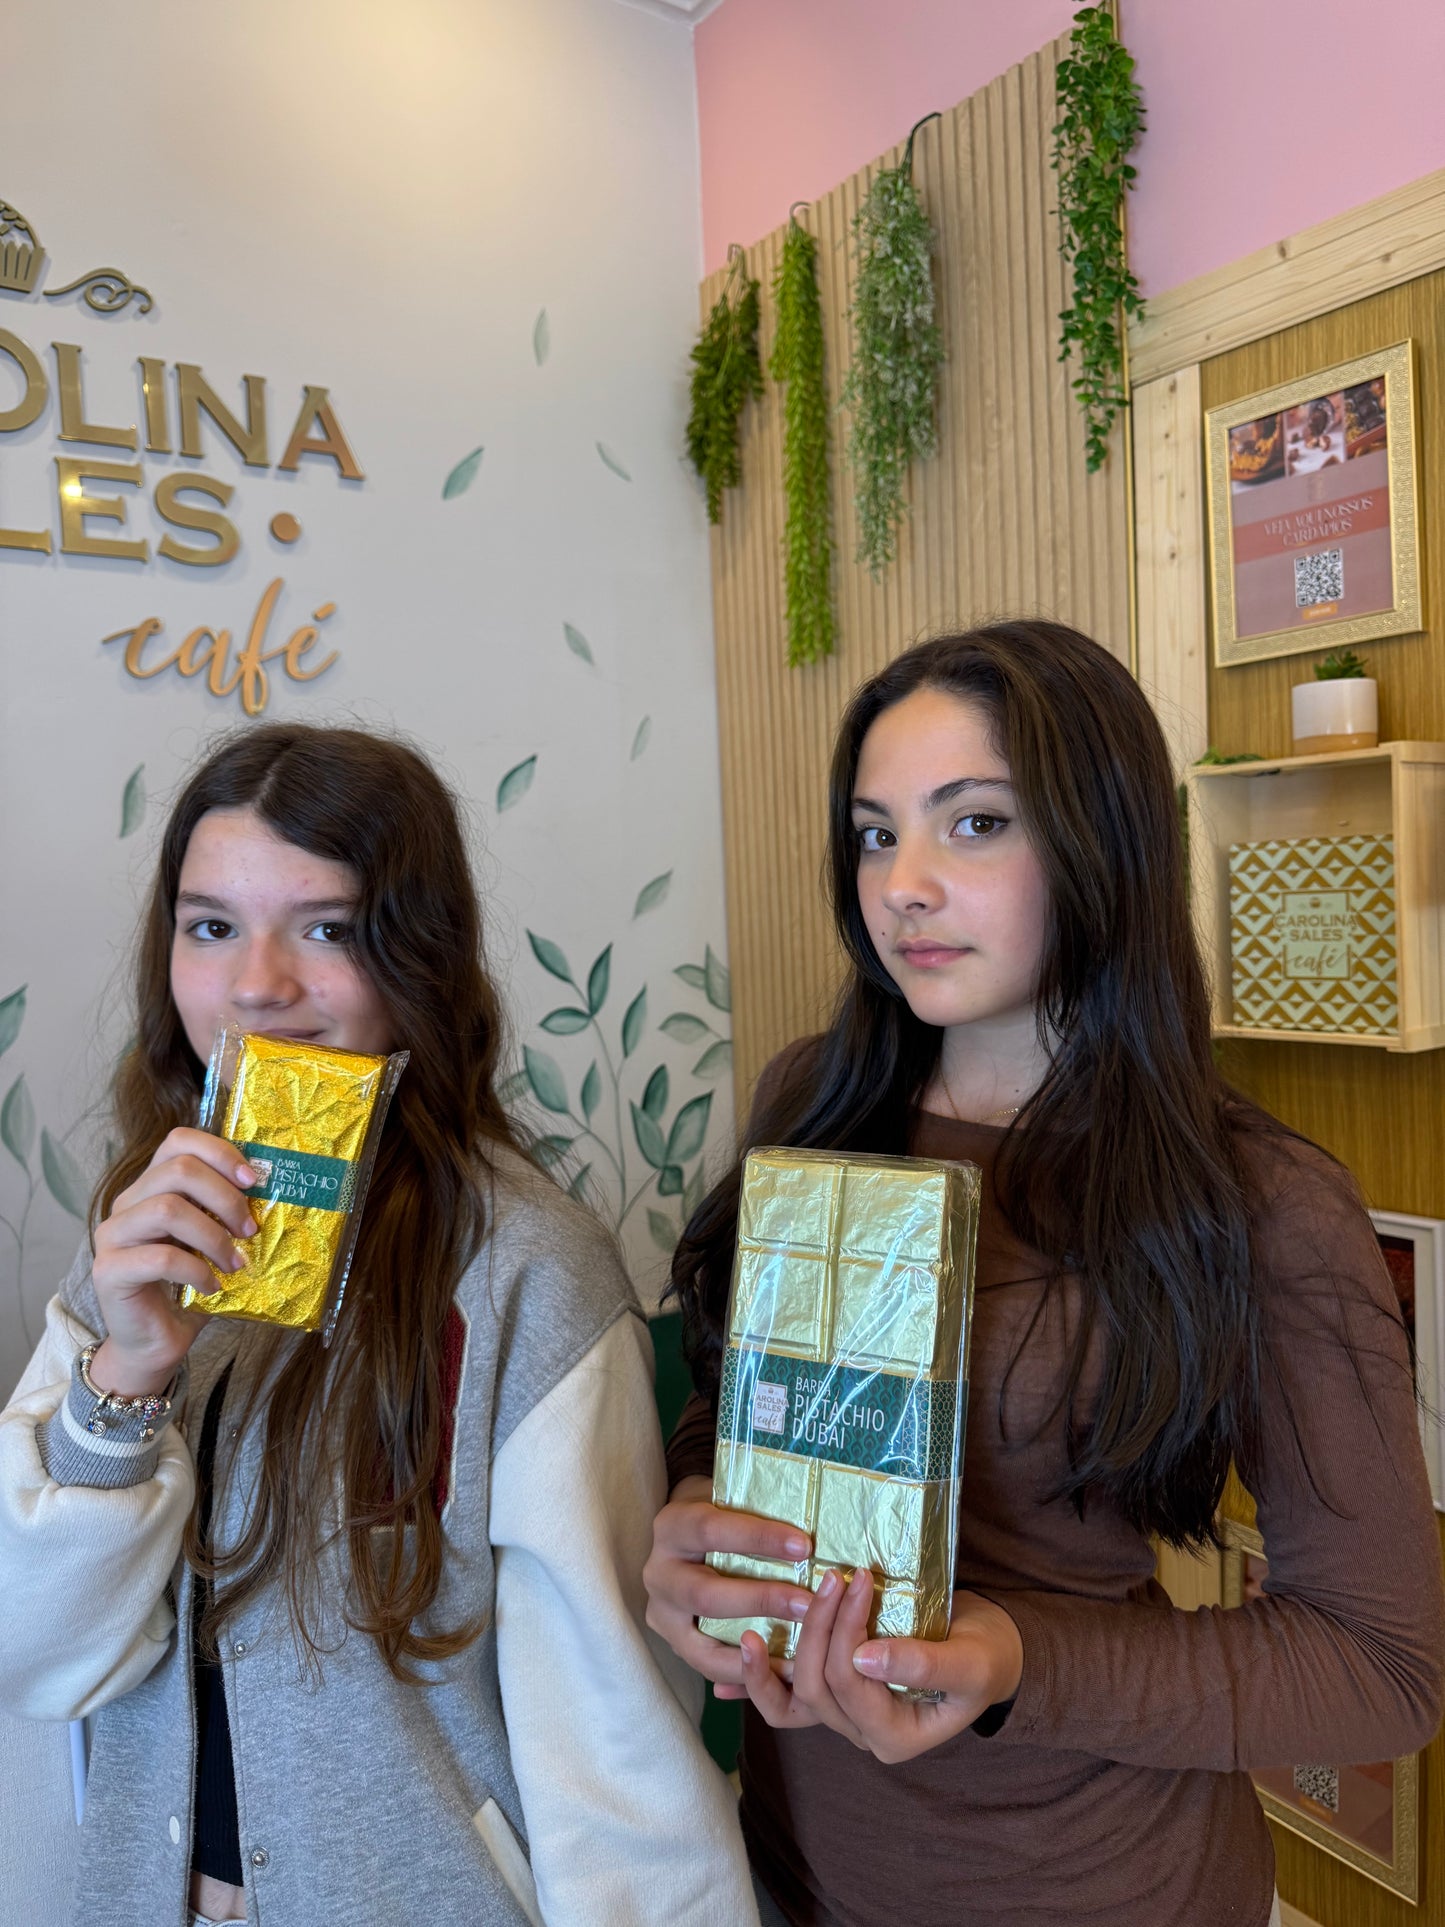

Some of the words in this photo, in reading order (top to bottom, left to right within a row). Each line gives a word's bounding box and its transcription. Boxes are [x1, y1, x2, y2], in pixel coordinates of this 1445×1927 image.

[102, 578, 340, 715] café
[1272, 914, 1358, 930] CAROLINA
[1290, 928, 1343, 942] SALES
[1287, 944, 1347, 976] café
[277, 1158, 301, 1170] BARRA
[274, 1165, 338, 1190] PISTACHIO
[270, 1181, 307, 1199] DUBAI
[756, 1401, 782, 1412] SALES
[792, 1417, 846, 1449] DUBAI
